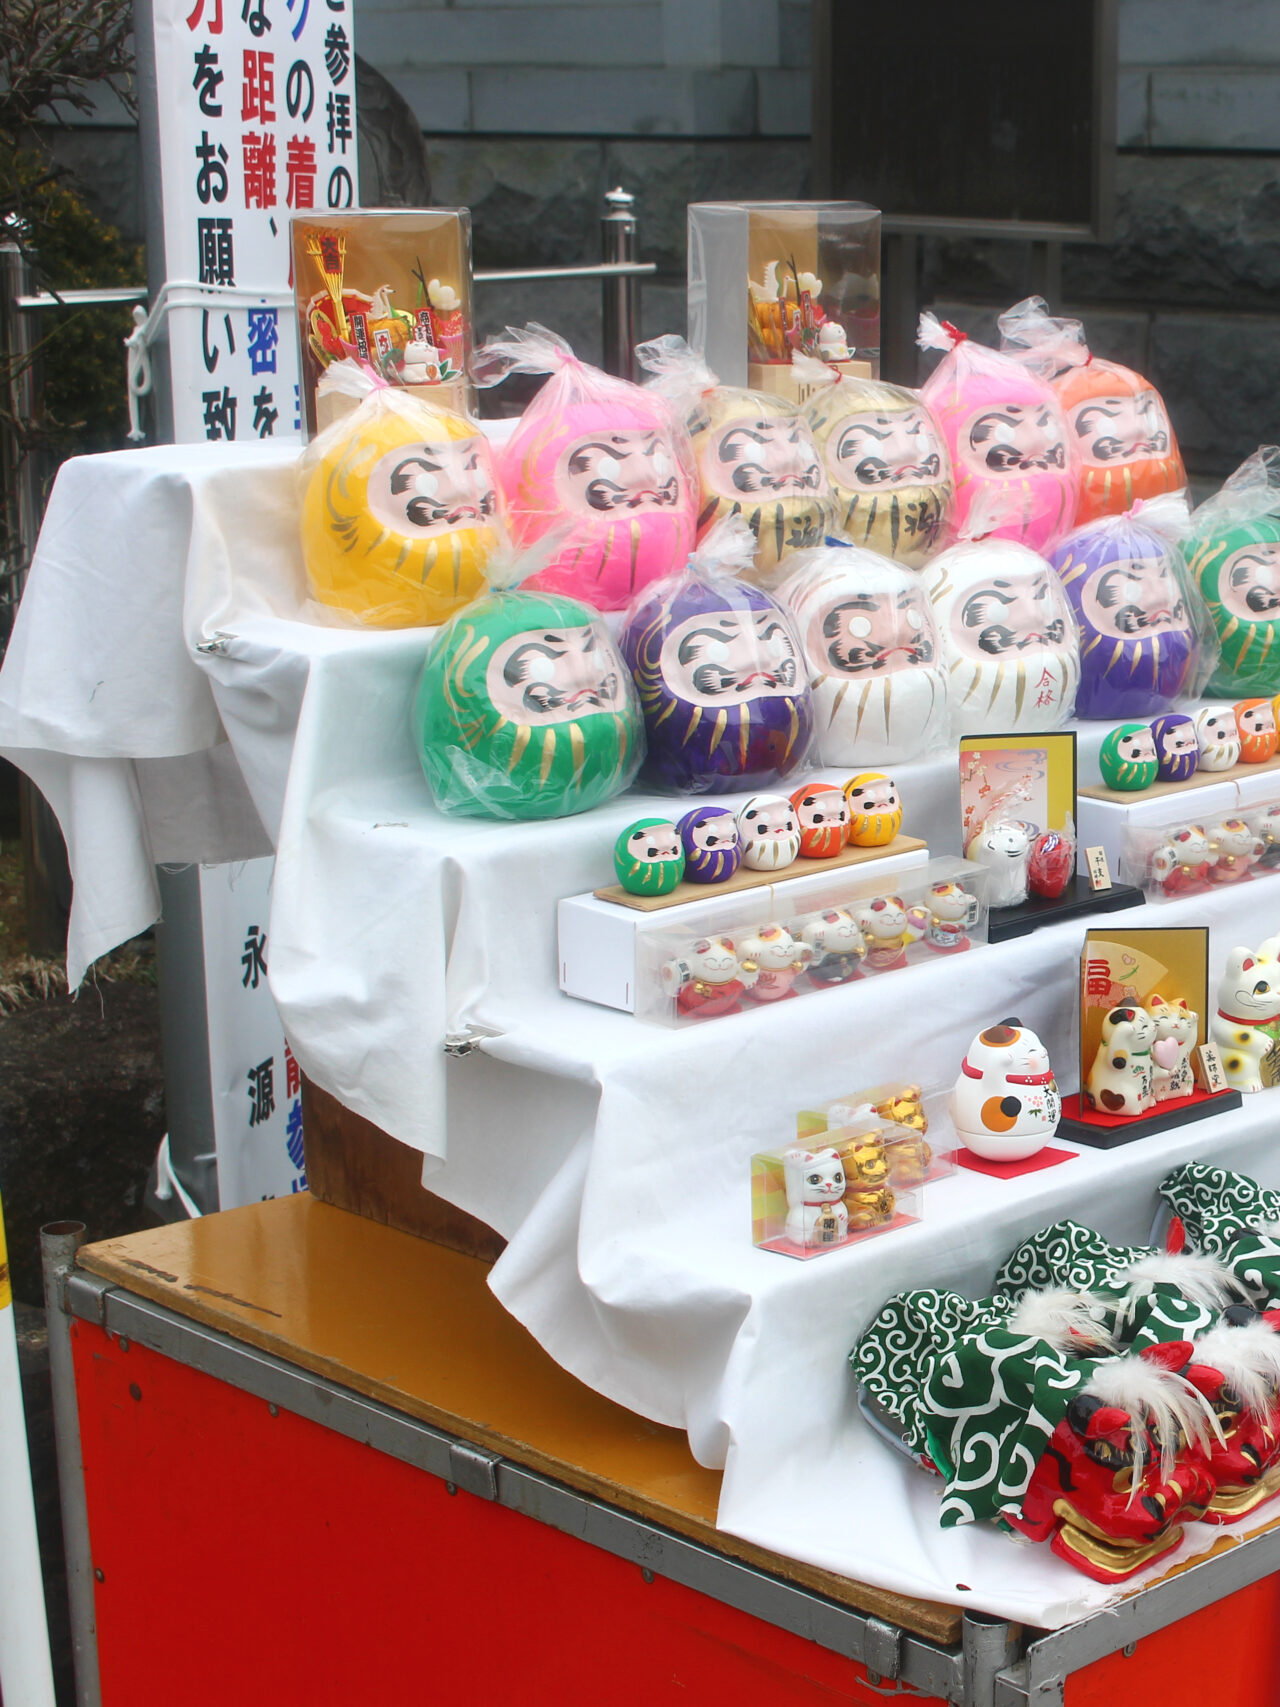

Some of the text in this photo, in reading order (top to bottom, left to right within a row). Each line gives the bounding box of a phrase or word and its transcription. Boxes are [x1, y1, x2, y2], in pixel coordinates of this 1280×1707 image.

[286, 0, 317, 288] クの着
[325, 0, 354, 208] 参拝の
[1034, 667, 1057, 709] 合格
[241, 925, 276, 1201] 永源
[1043, 1085, 1057, 1124] 大開運
